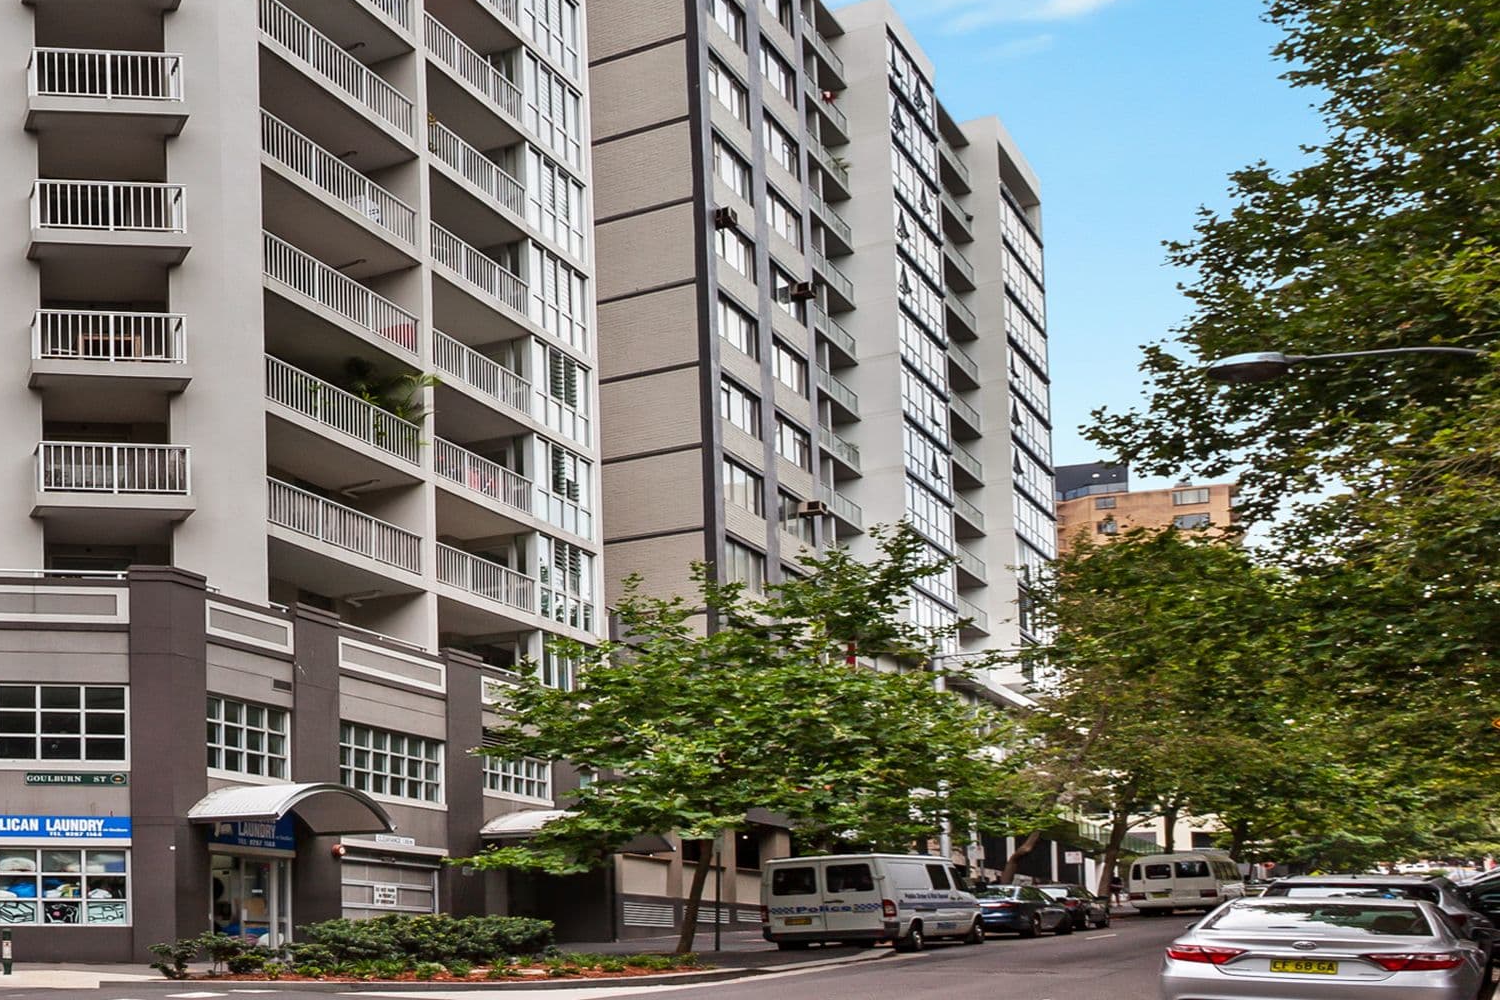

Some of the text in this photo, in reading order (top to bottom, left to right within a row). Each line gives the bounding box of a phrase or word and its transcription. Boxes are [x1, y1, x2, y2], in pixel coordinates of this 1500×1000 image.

[26, 775, 82, 783] GOULBURN
[46, 819, 104, 832] LAUNDRY
[238, 821, 276, 839] LAUNDRY
[796, 904, 852, 914] Police
[1317, 962, 1335, 972] GA
